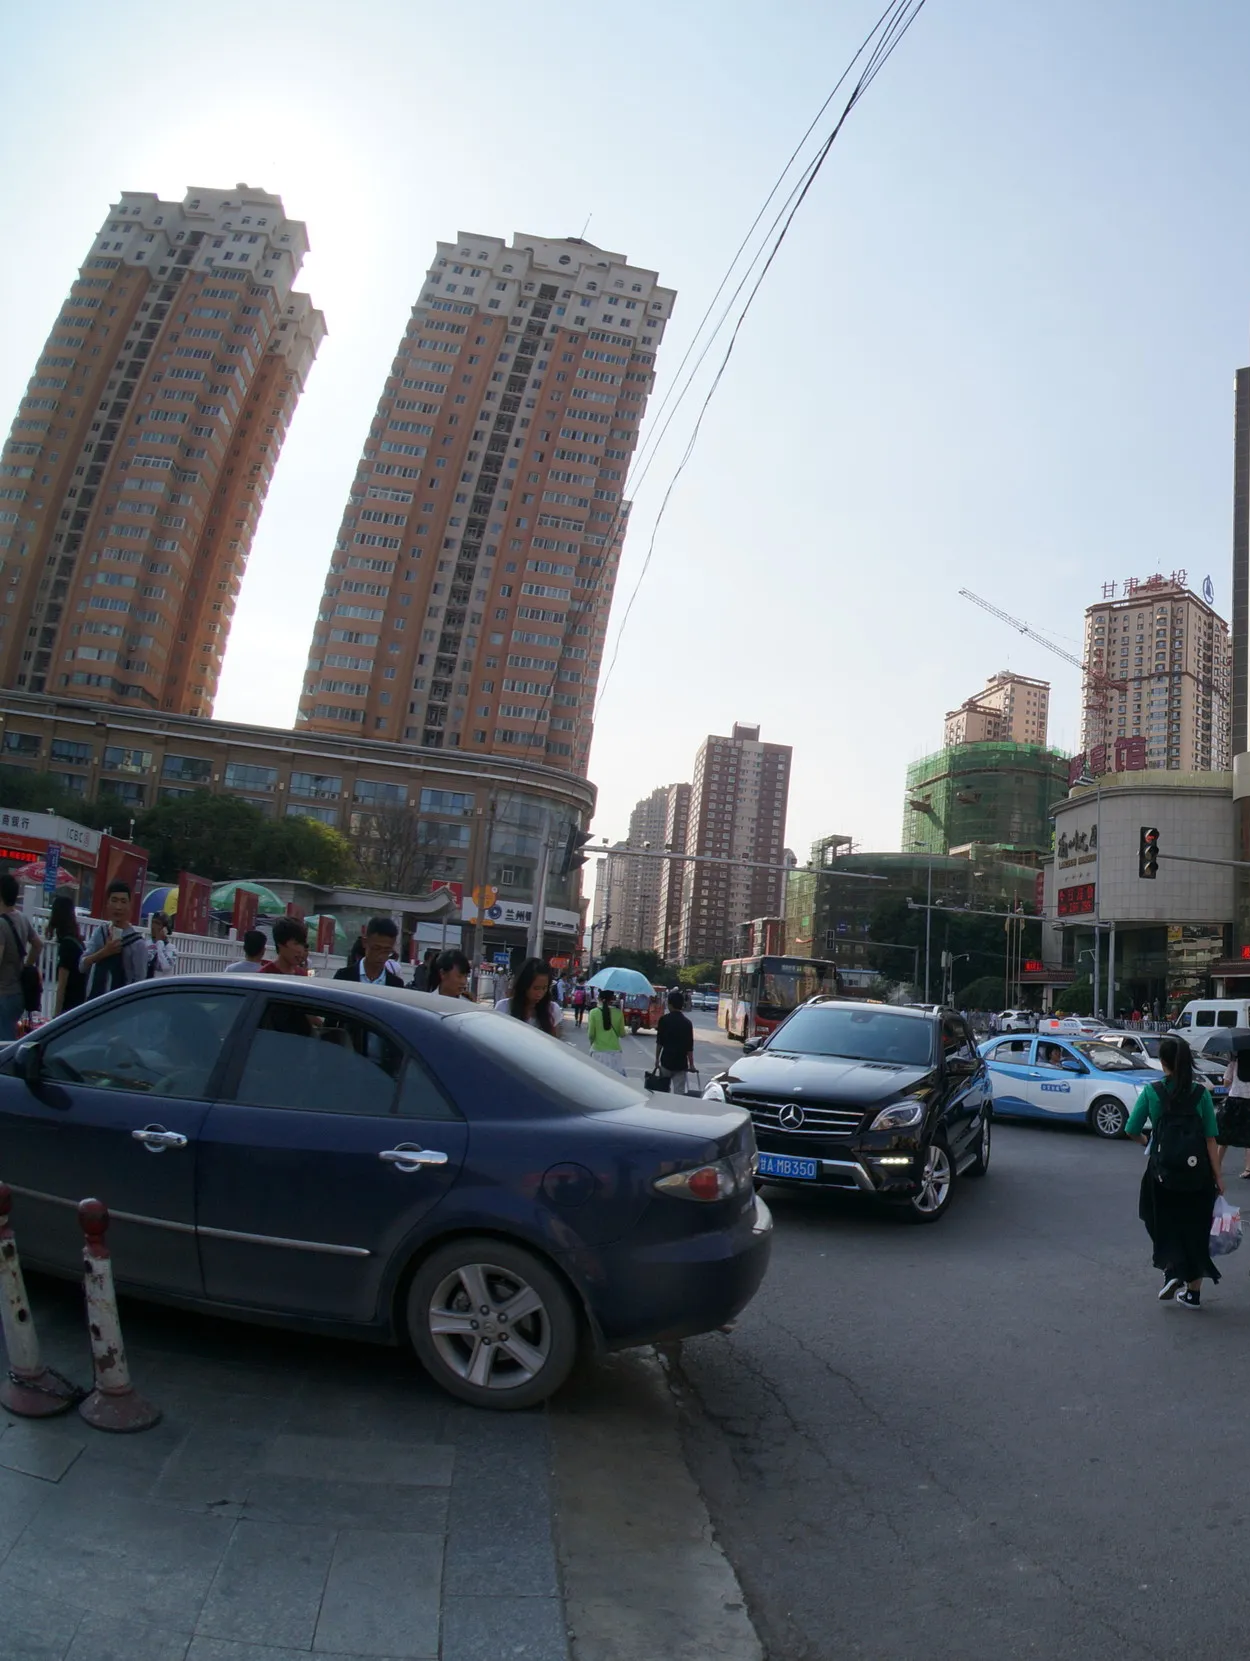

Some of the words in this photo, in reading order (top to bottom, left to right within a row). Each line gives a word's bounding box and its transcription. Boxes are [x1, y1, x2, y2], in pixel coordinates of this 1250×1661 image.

[1101, 568, 1188, 599] 甘肃建投
[0, 813, 30, 830] 商银行
[66, 827, 83, 844] ICBC
